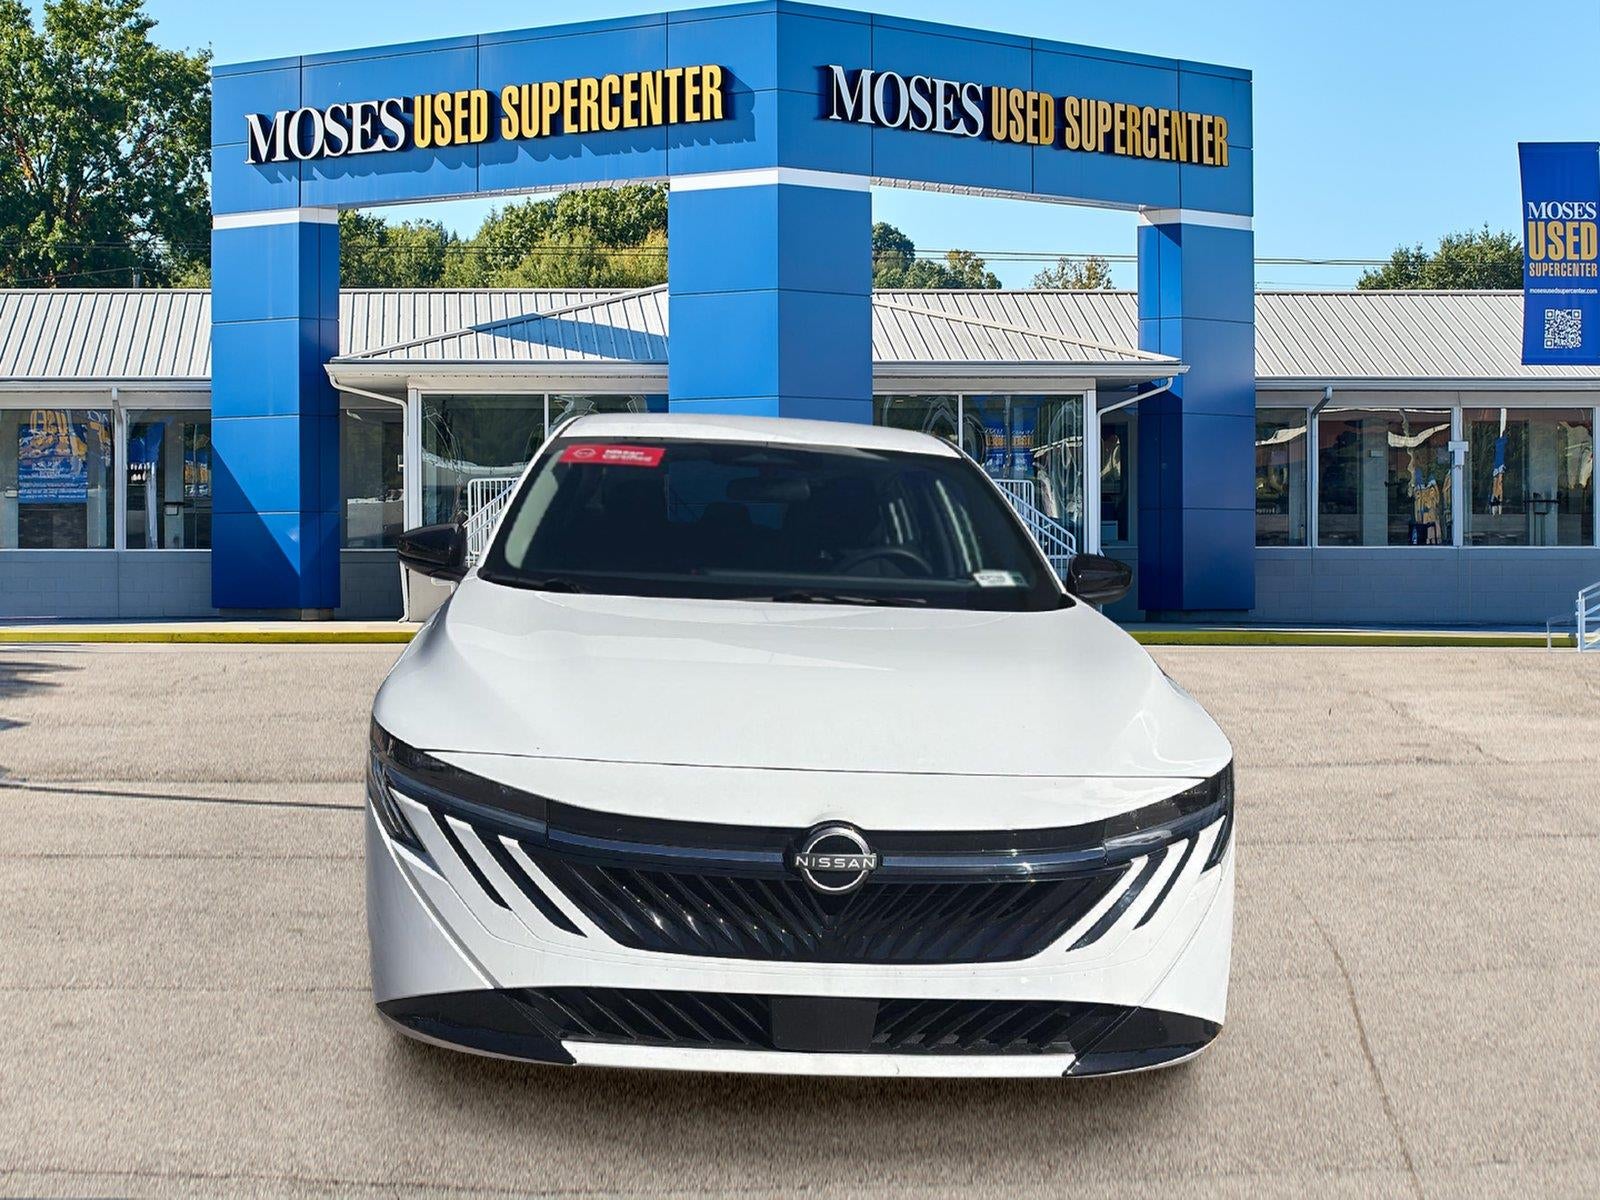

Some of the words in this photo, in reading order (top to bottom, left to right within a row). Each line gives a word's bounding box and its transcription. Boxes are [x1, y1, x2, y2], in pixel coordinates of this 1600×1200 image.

[244, 98, 408, 165] MOSES
[414, 90, 488, 148] USED
[502, 64, 724, 140] SUPERCENTER
[829, 64, 983, 137] MOSES
[991, 86, 1056, 146] USED
[1065, 95, 1230, 167] SUPERCENTER
[1528, 201, 1597, 220] MOSES
[1528, 221, 1598, 260] USED
[1529, 262, 1598, 277] SUPERCENTER
[1529, 287, 1598, 295] mosesusedsupercenter.com
[795, 855, 876, 869] NISSAN
